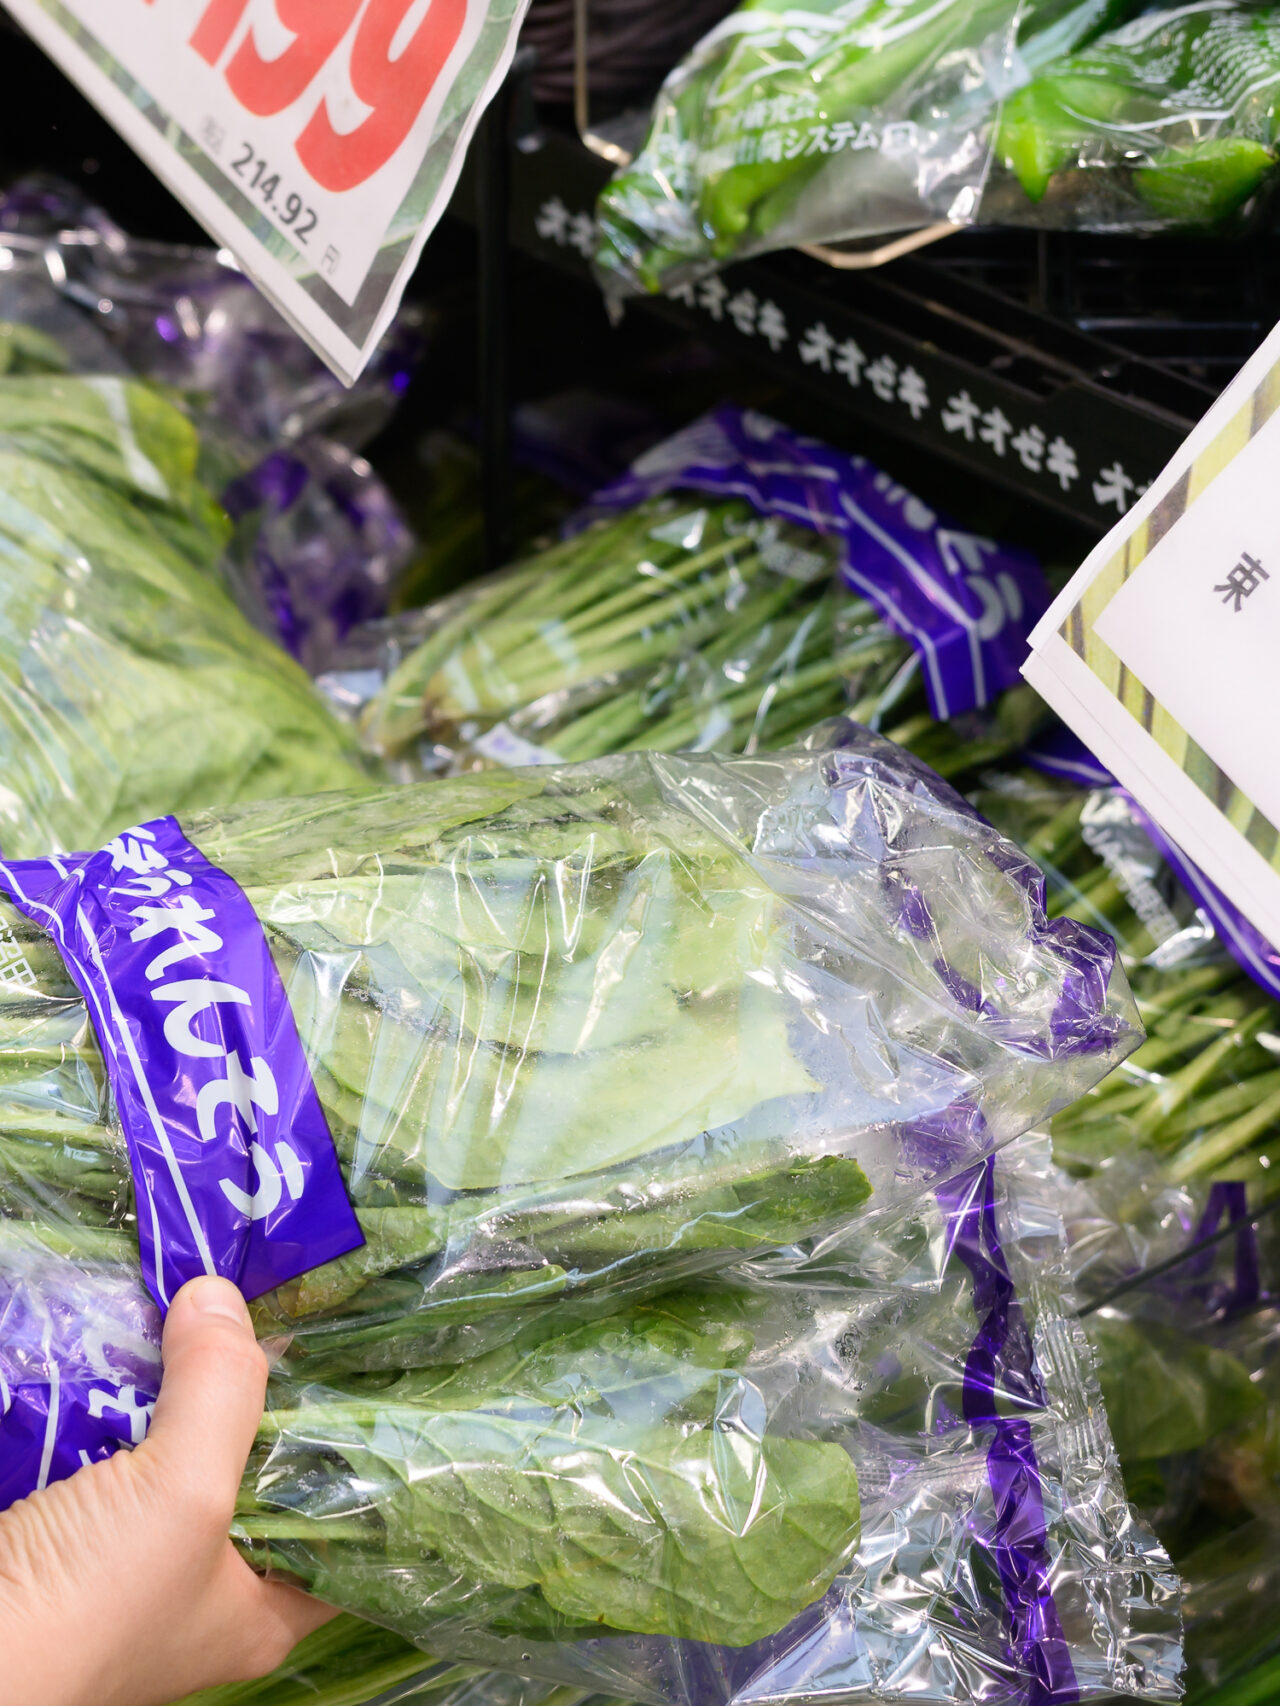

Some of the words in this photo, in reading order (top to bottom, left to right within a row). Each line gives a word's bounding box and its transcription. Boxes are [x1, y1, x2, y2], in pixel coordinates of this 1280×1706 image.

[231, 141, 318, 245] 214.92
[798, 321, 930, 421] オオゼキ
[941, 389, 1080, 491] オオゼキ
[98, 824, 306, 1222] ほうれんそう
